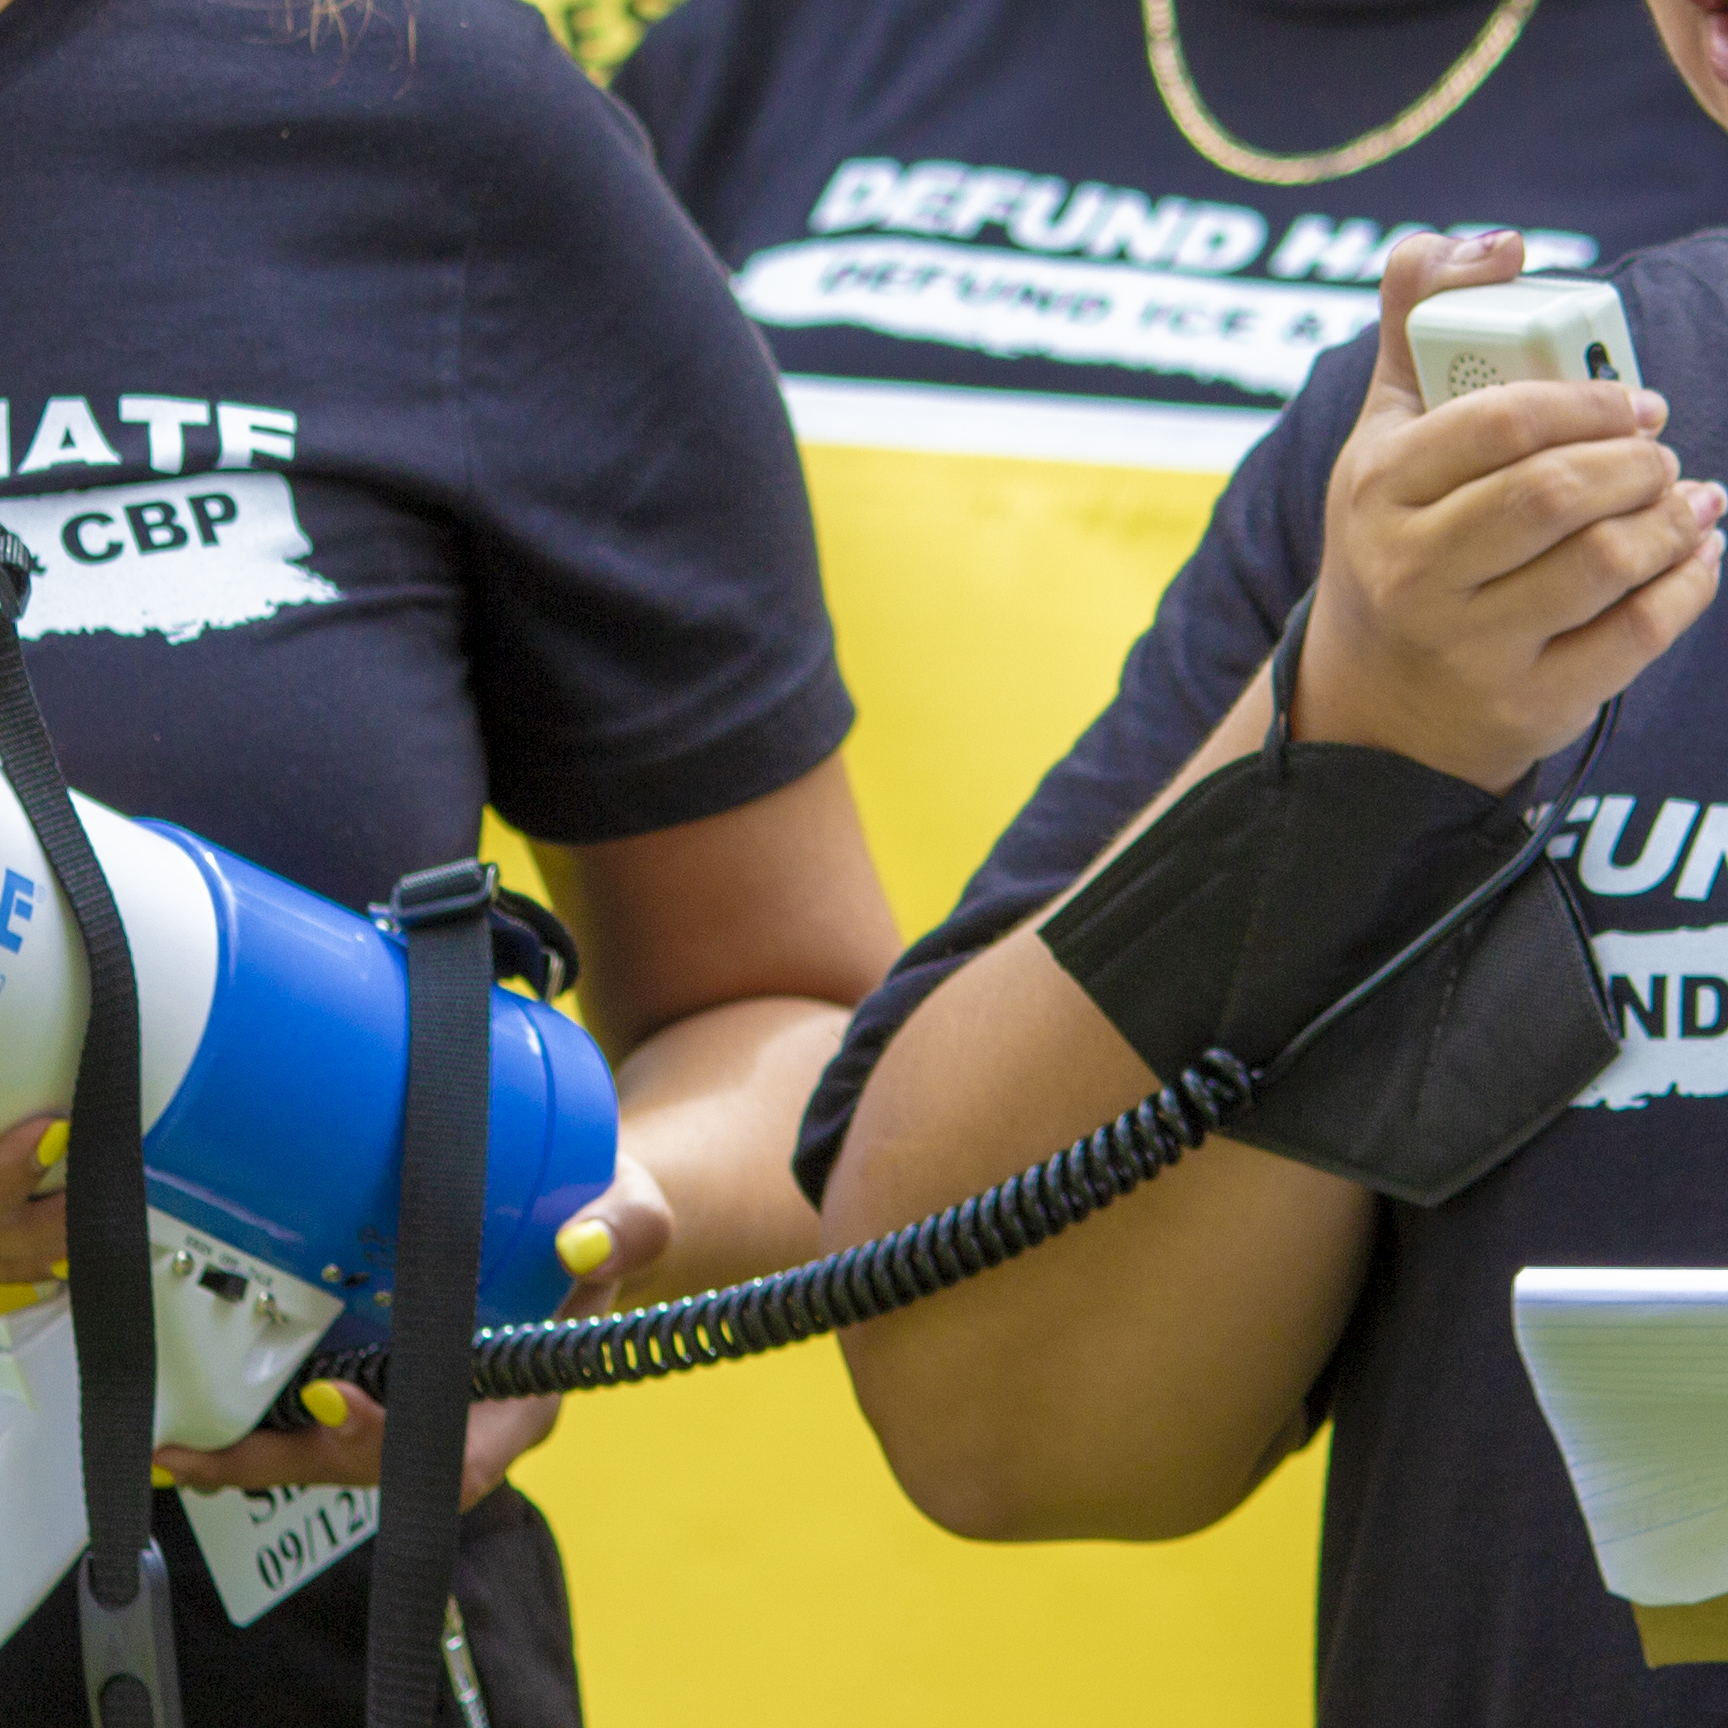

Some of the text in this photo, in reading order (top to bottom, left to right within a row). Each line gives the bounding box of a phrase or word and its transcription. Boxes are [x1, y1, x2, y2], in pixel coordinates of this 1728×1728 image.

[807, 157, 1270, 275] DEFUND
[820, 252, 1114, 324] DEFUND
[60, 492, 239, 566] CBP
